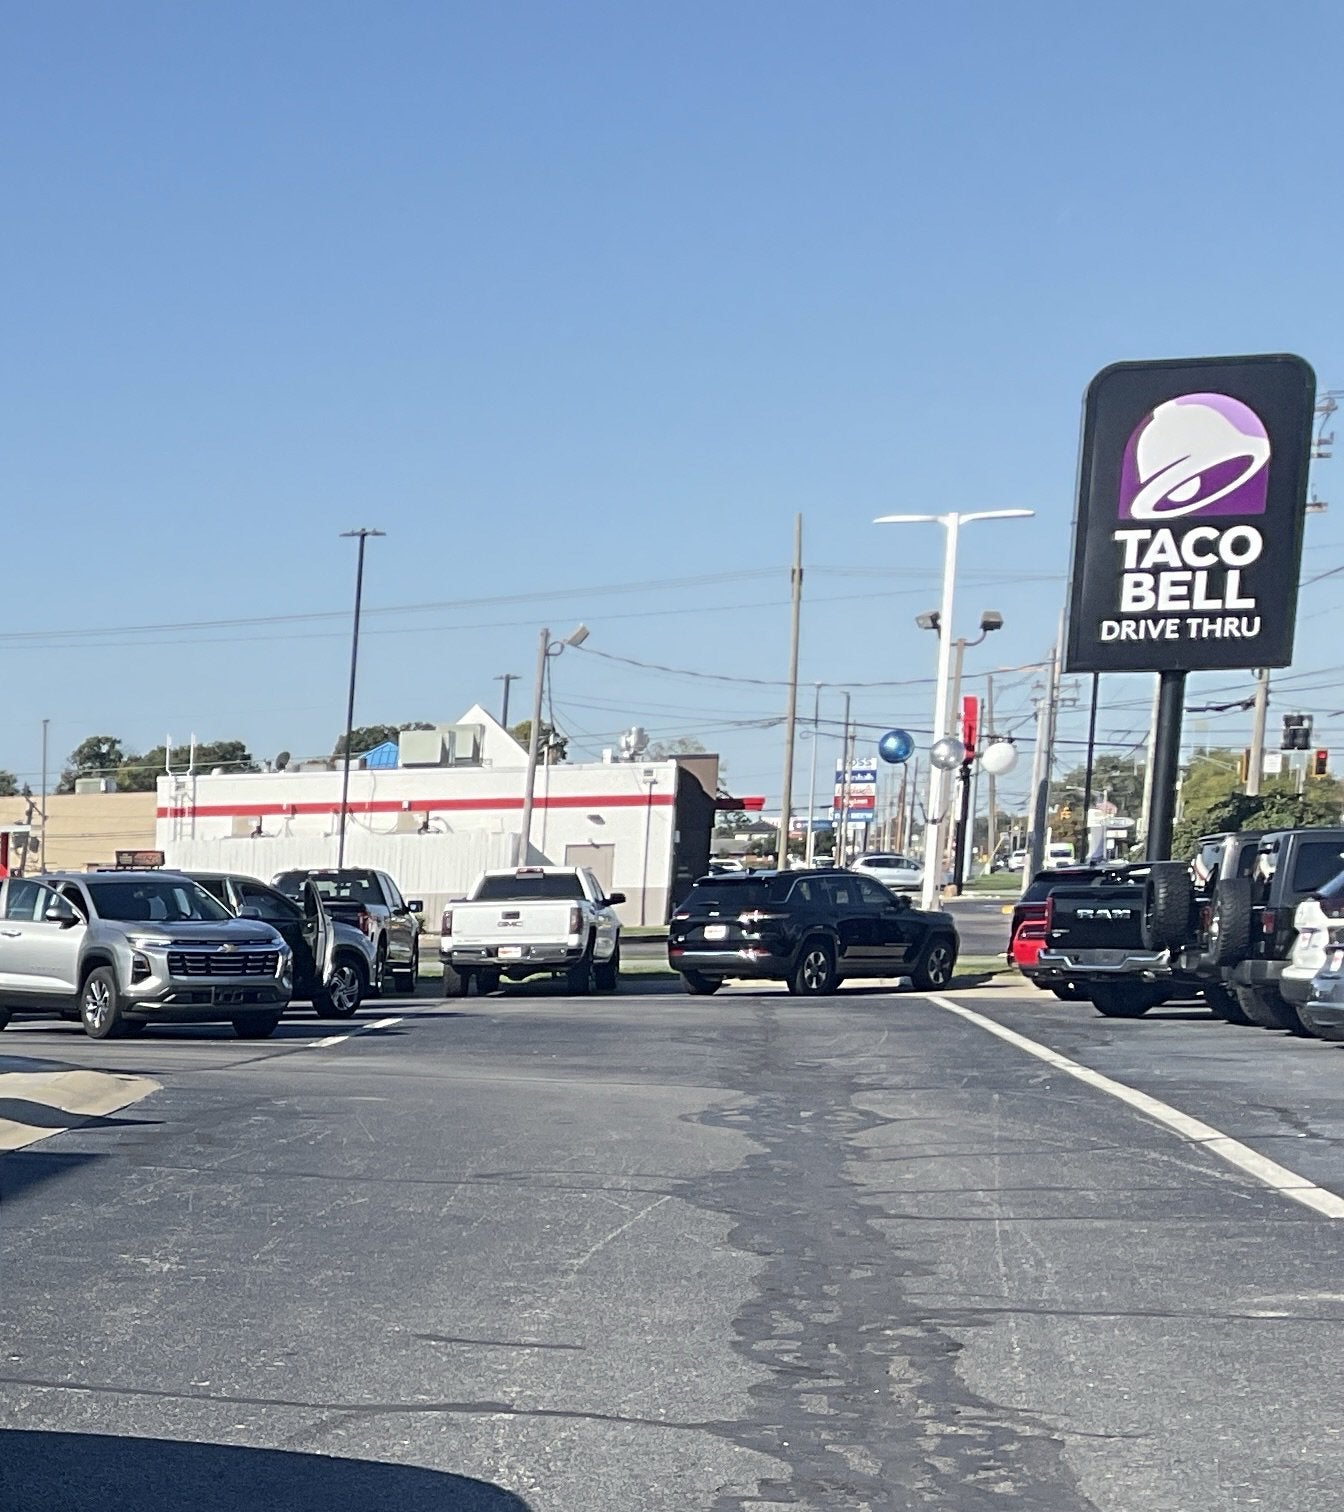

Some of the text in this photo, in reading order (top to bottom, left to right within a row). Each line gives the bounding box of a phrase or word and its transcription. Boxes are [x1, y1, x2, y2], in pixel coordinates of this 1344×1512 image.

[1114, 525, 1263, 569] TACO
[1120, 569, 1255, 613] BELL
[1100, 616, 1261, 641] DRIVE THRU
[1076, 909, 1131, 919] RAM
